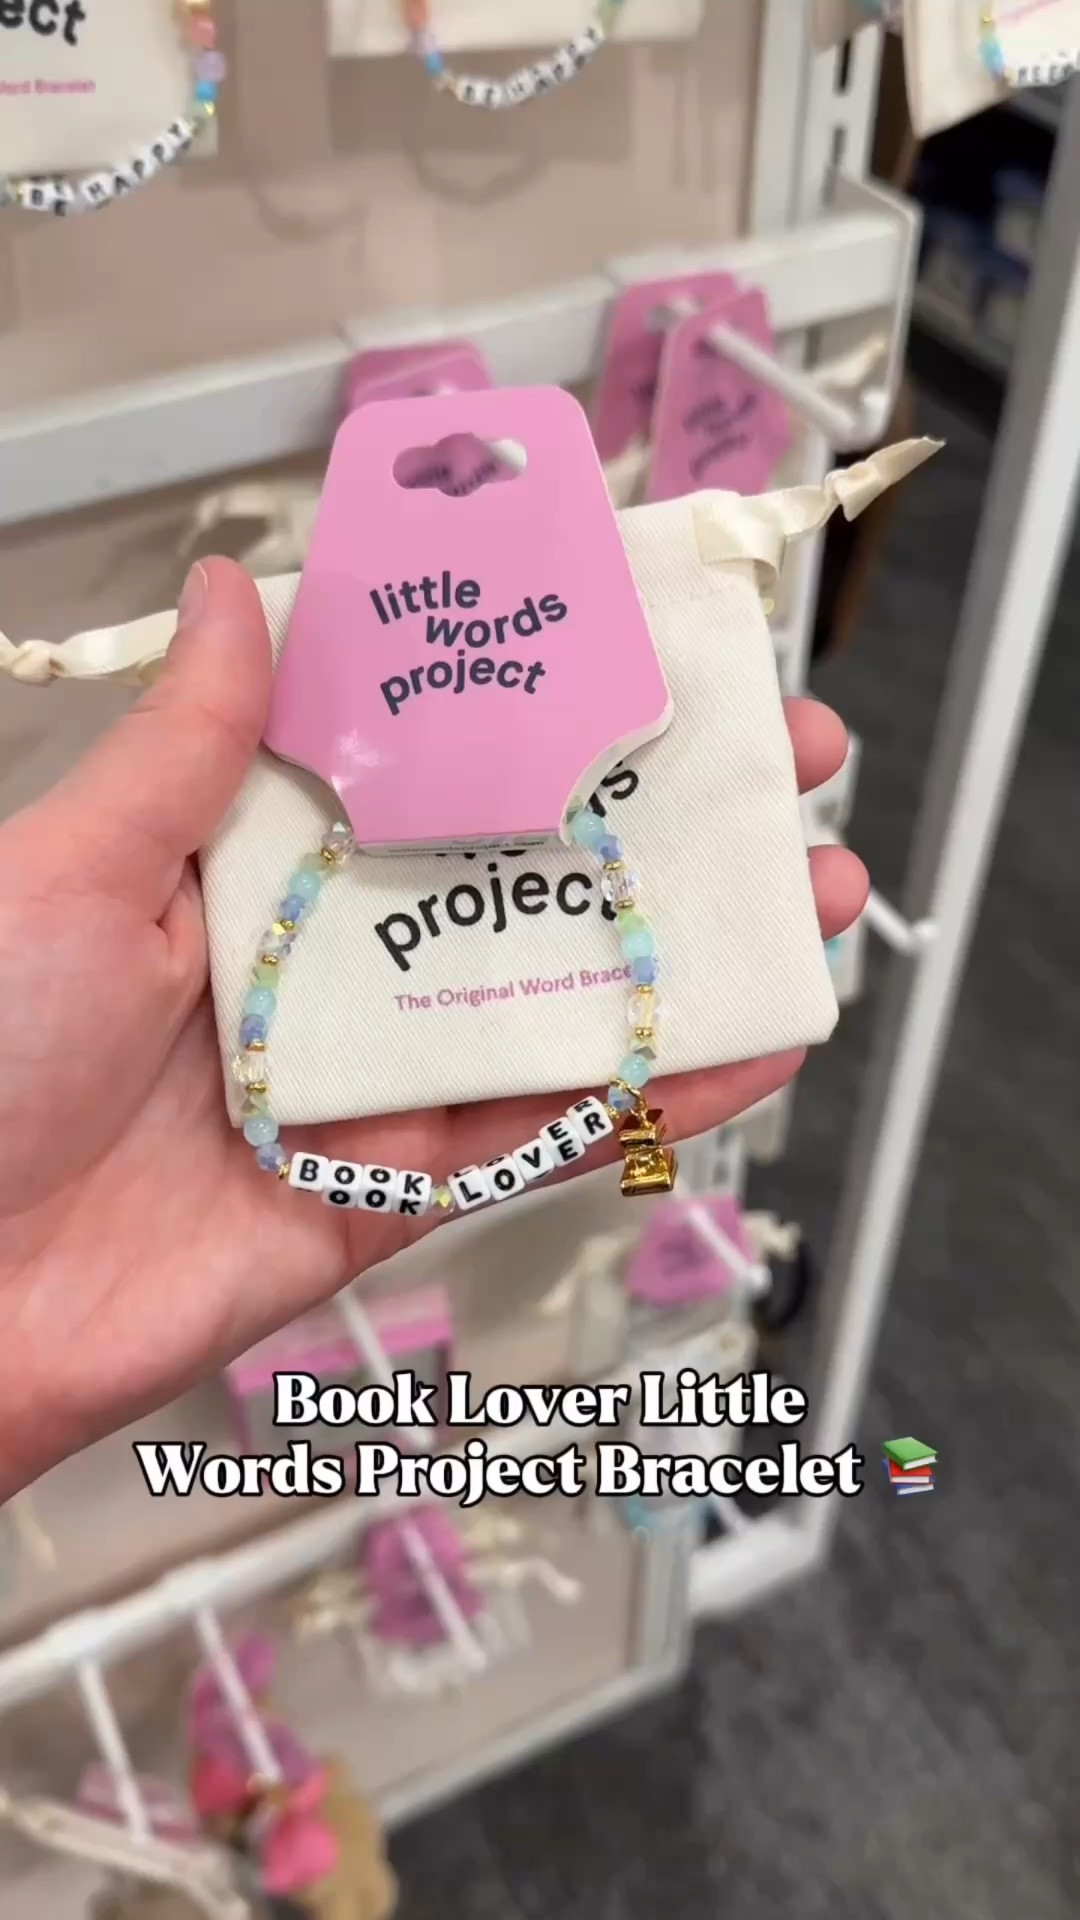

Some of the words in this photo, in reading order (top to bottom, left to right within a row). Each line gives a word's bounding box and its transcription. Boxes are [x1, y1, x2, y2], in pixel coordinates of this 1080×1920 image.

[86, 122, 190, 203] HAPPY
[369, 570, 481, 625] little
[425, 593, 568, 648] words
[379, 649, 546, 717] project
[394, 994, 432, 1011] The
[436, 980, 514, 1008] Original
[518, 972, 575, 996] Word
[298, 1156, 424, 1216] BOOK
[452, 1095, 607, 1204] LOVER
